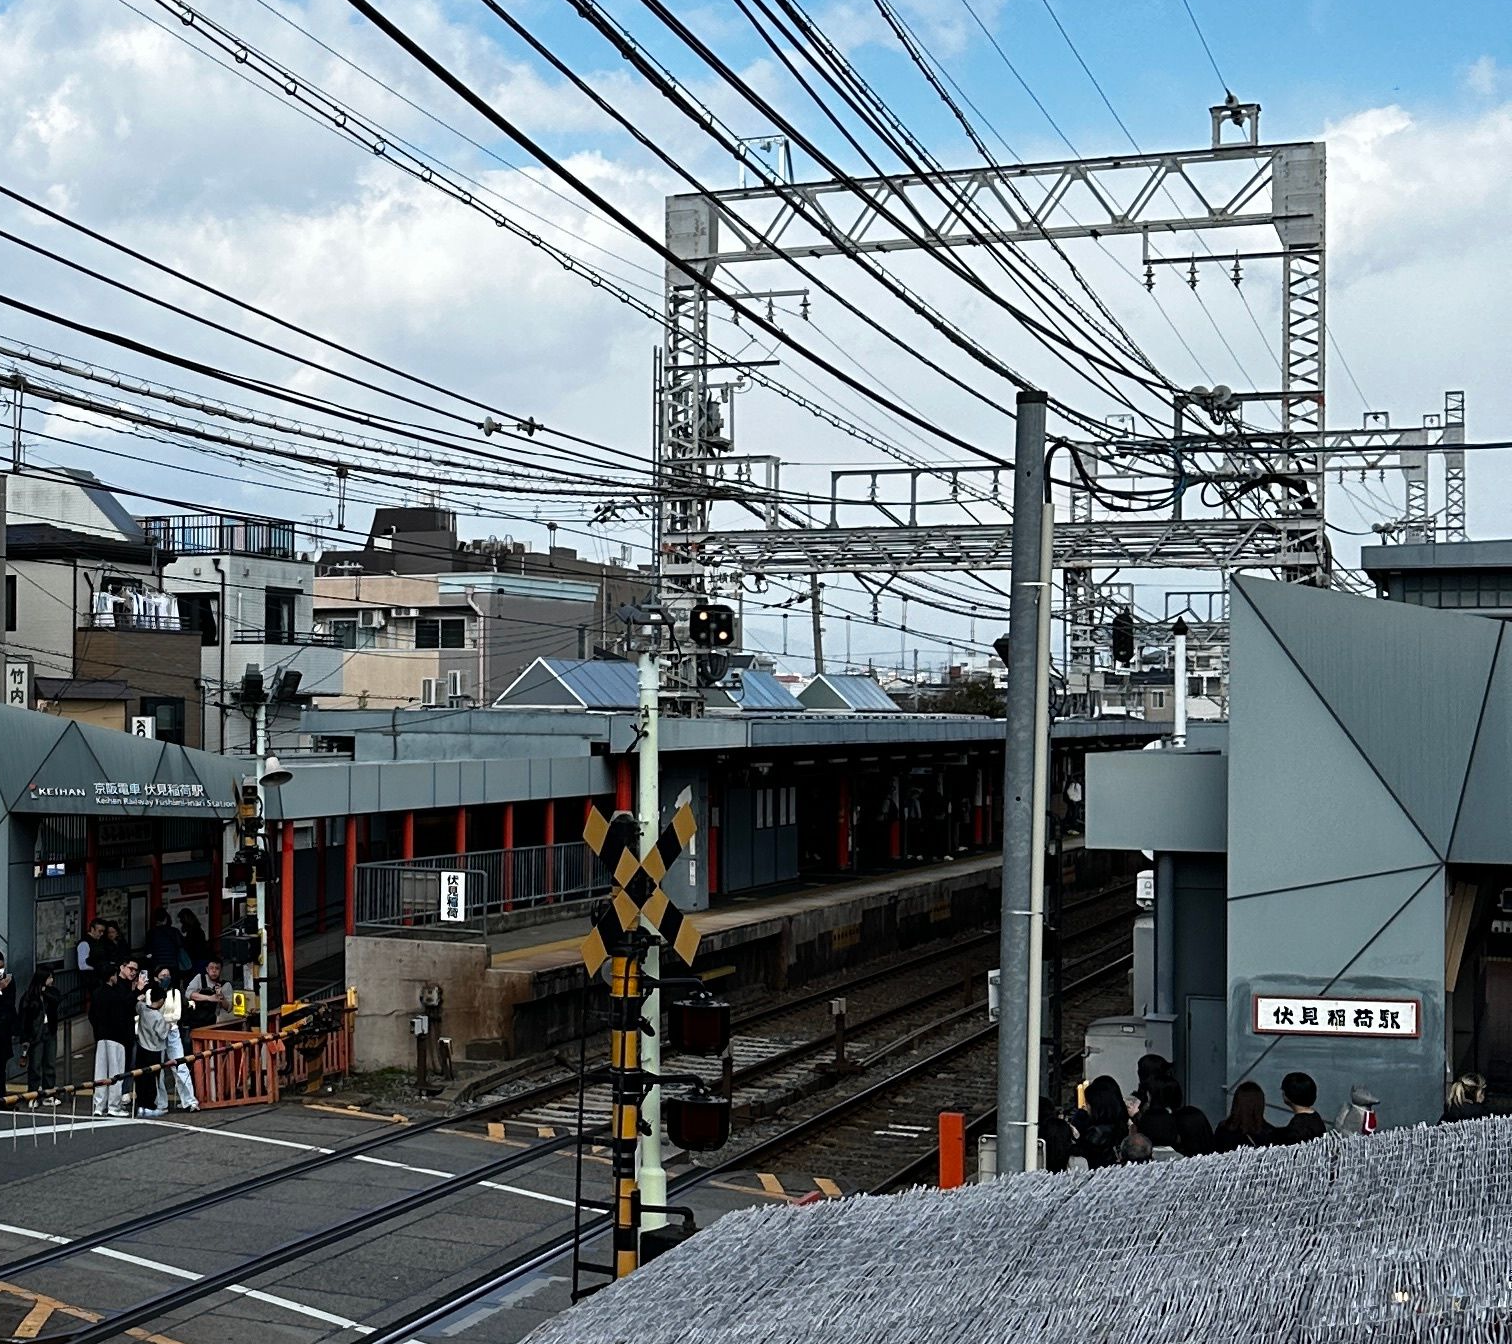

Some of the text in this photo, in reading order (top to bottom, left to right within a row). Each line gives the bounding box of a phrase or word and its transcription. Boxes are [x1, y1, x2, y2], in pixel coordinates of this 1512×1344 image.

[10, 667, 24, 704] 竹内
[38, 787, 85, 796] KEIHAN
[93, 782, 204, 797] 京阪電車 伏見稲荷駅
[207, 799, 236, 808] Station
[447, 874, 459, 918] 伏見稲荷
[1272, 1006, 1401, 1029] 伏見稲荷駅
